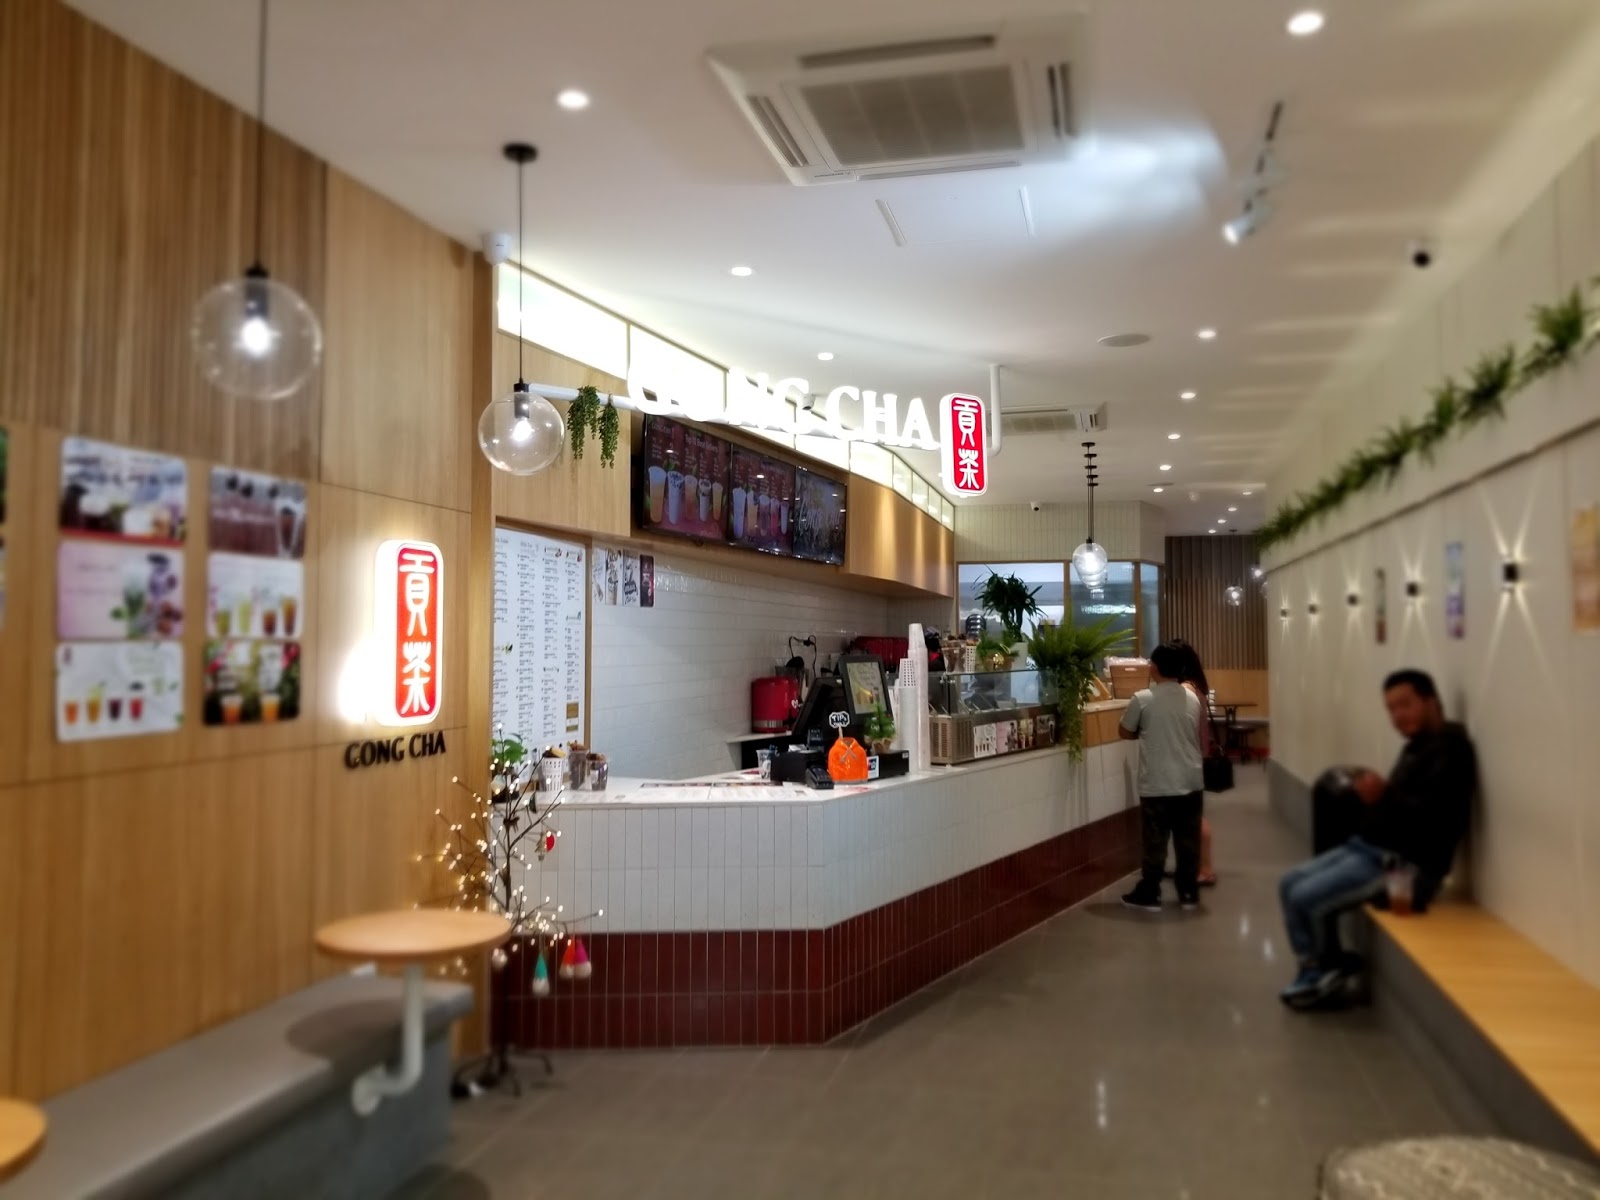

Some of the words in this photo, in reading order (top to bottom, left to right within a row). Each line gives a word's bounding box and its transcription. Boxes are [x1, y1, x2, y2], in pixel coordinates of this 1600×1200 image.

[627, 349, 809, 435] GNG
[825, 385, 940, 450] CHA
[953, 399, 980, 489] 貢茶
[399, 552, 435, 715] 貢茶
[344, 736, 405, 769] GONG
[409, 729, 446, 759] CHA
